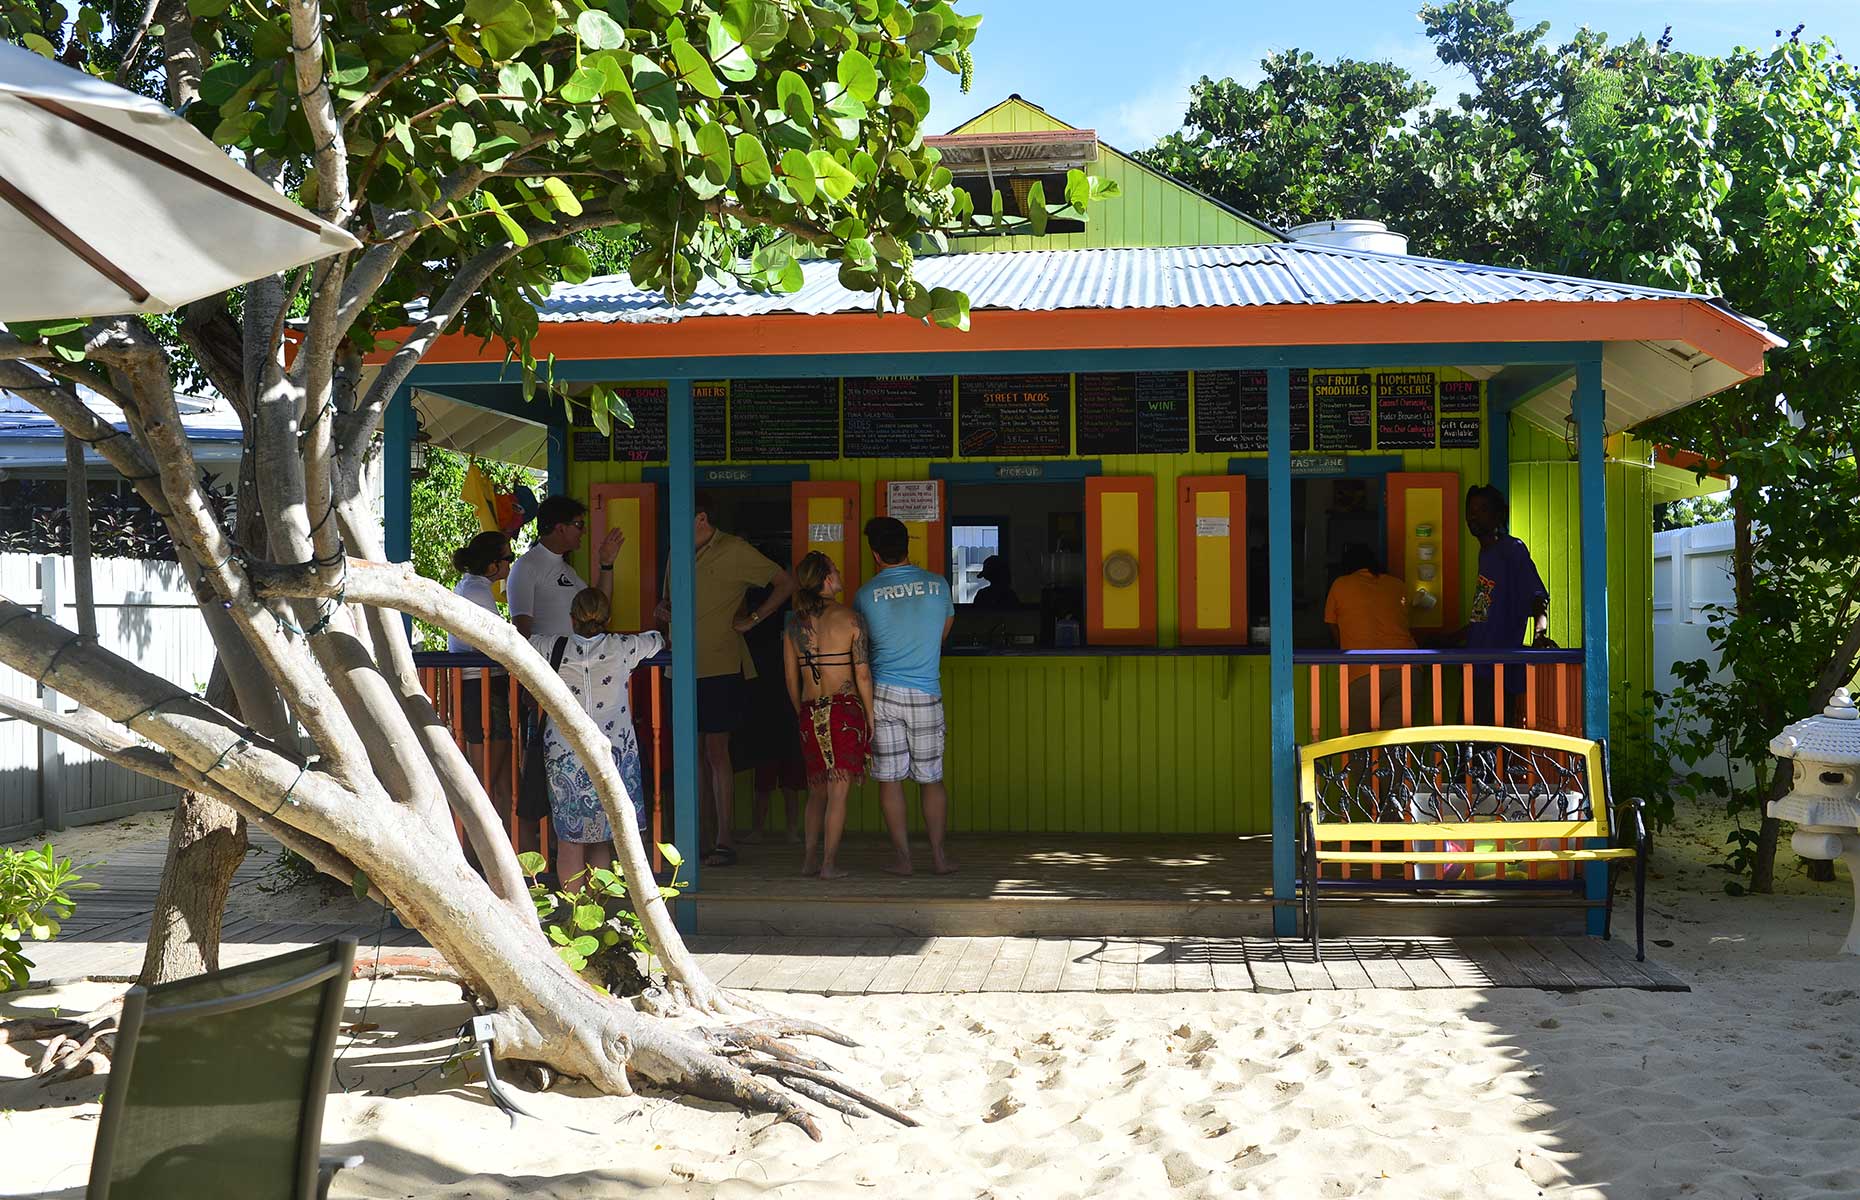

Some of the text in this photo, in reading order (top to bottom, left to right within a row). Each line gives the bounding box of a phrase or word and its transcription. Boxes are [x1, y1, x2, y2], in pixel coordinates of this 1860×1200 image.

[1328, 375, 1360, 385] FRUIT
[1380, 374, 1432, 385] HOMEMADE
[1315, 385, 1369, 396] SMOOTHIES
[1380, 385, 1432, 396] DESSERTS
[1445, 383, 1473, 393] OPEN
[635, 389, 666, 398] BOWLS
[983, 392, 1050, 402] STREET TACOS
[1147, 400, 1176, 411] WINE
[1441, 420, 1479, 429] Gift Cards
[1214, 433, 1238, 443] Create
[1255, 434, 1268, 442] Ow
[1443, 429, 1474, 438] Available
[1291, 458, 1344, 467] FAST LANE
[708, 471, 746, 480] ORDER
[1000, 466, 1041, 477] PICK-UP
[873, 581, 941, 603] PROVE IT
